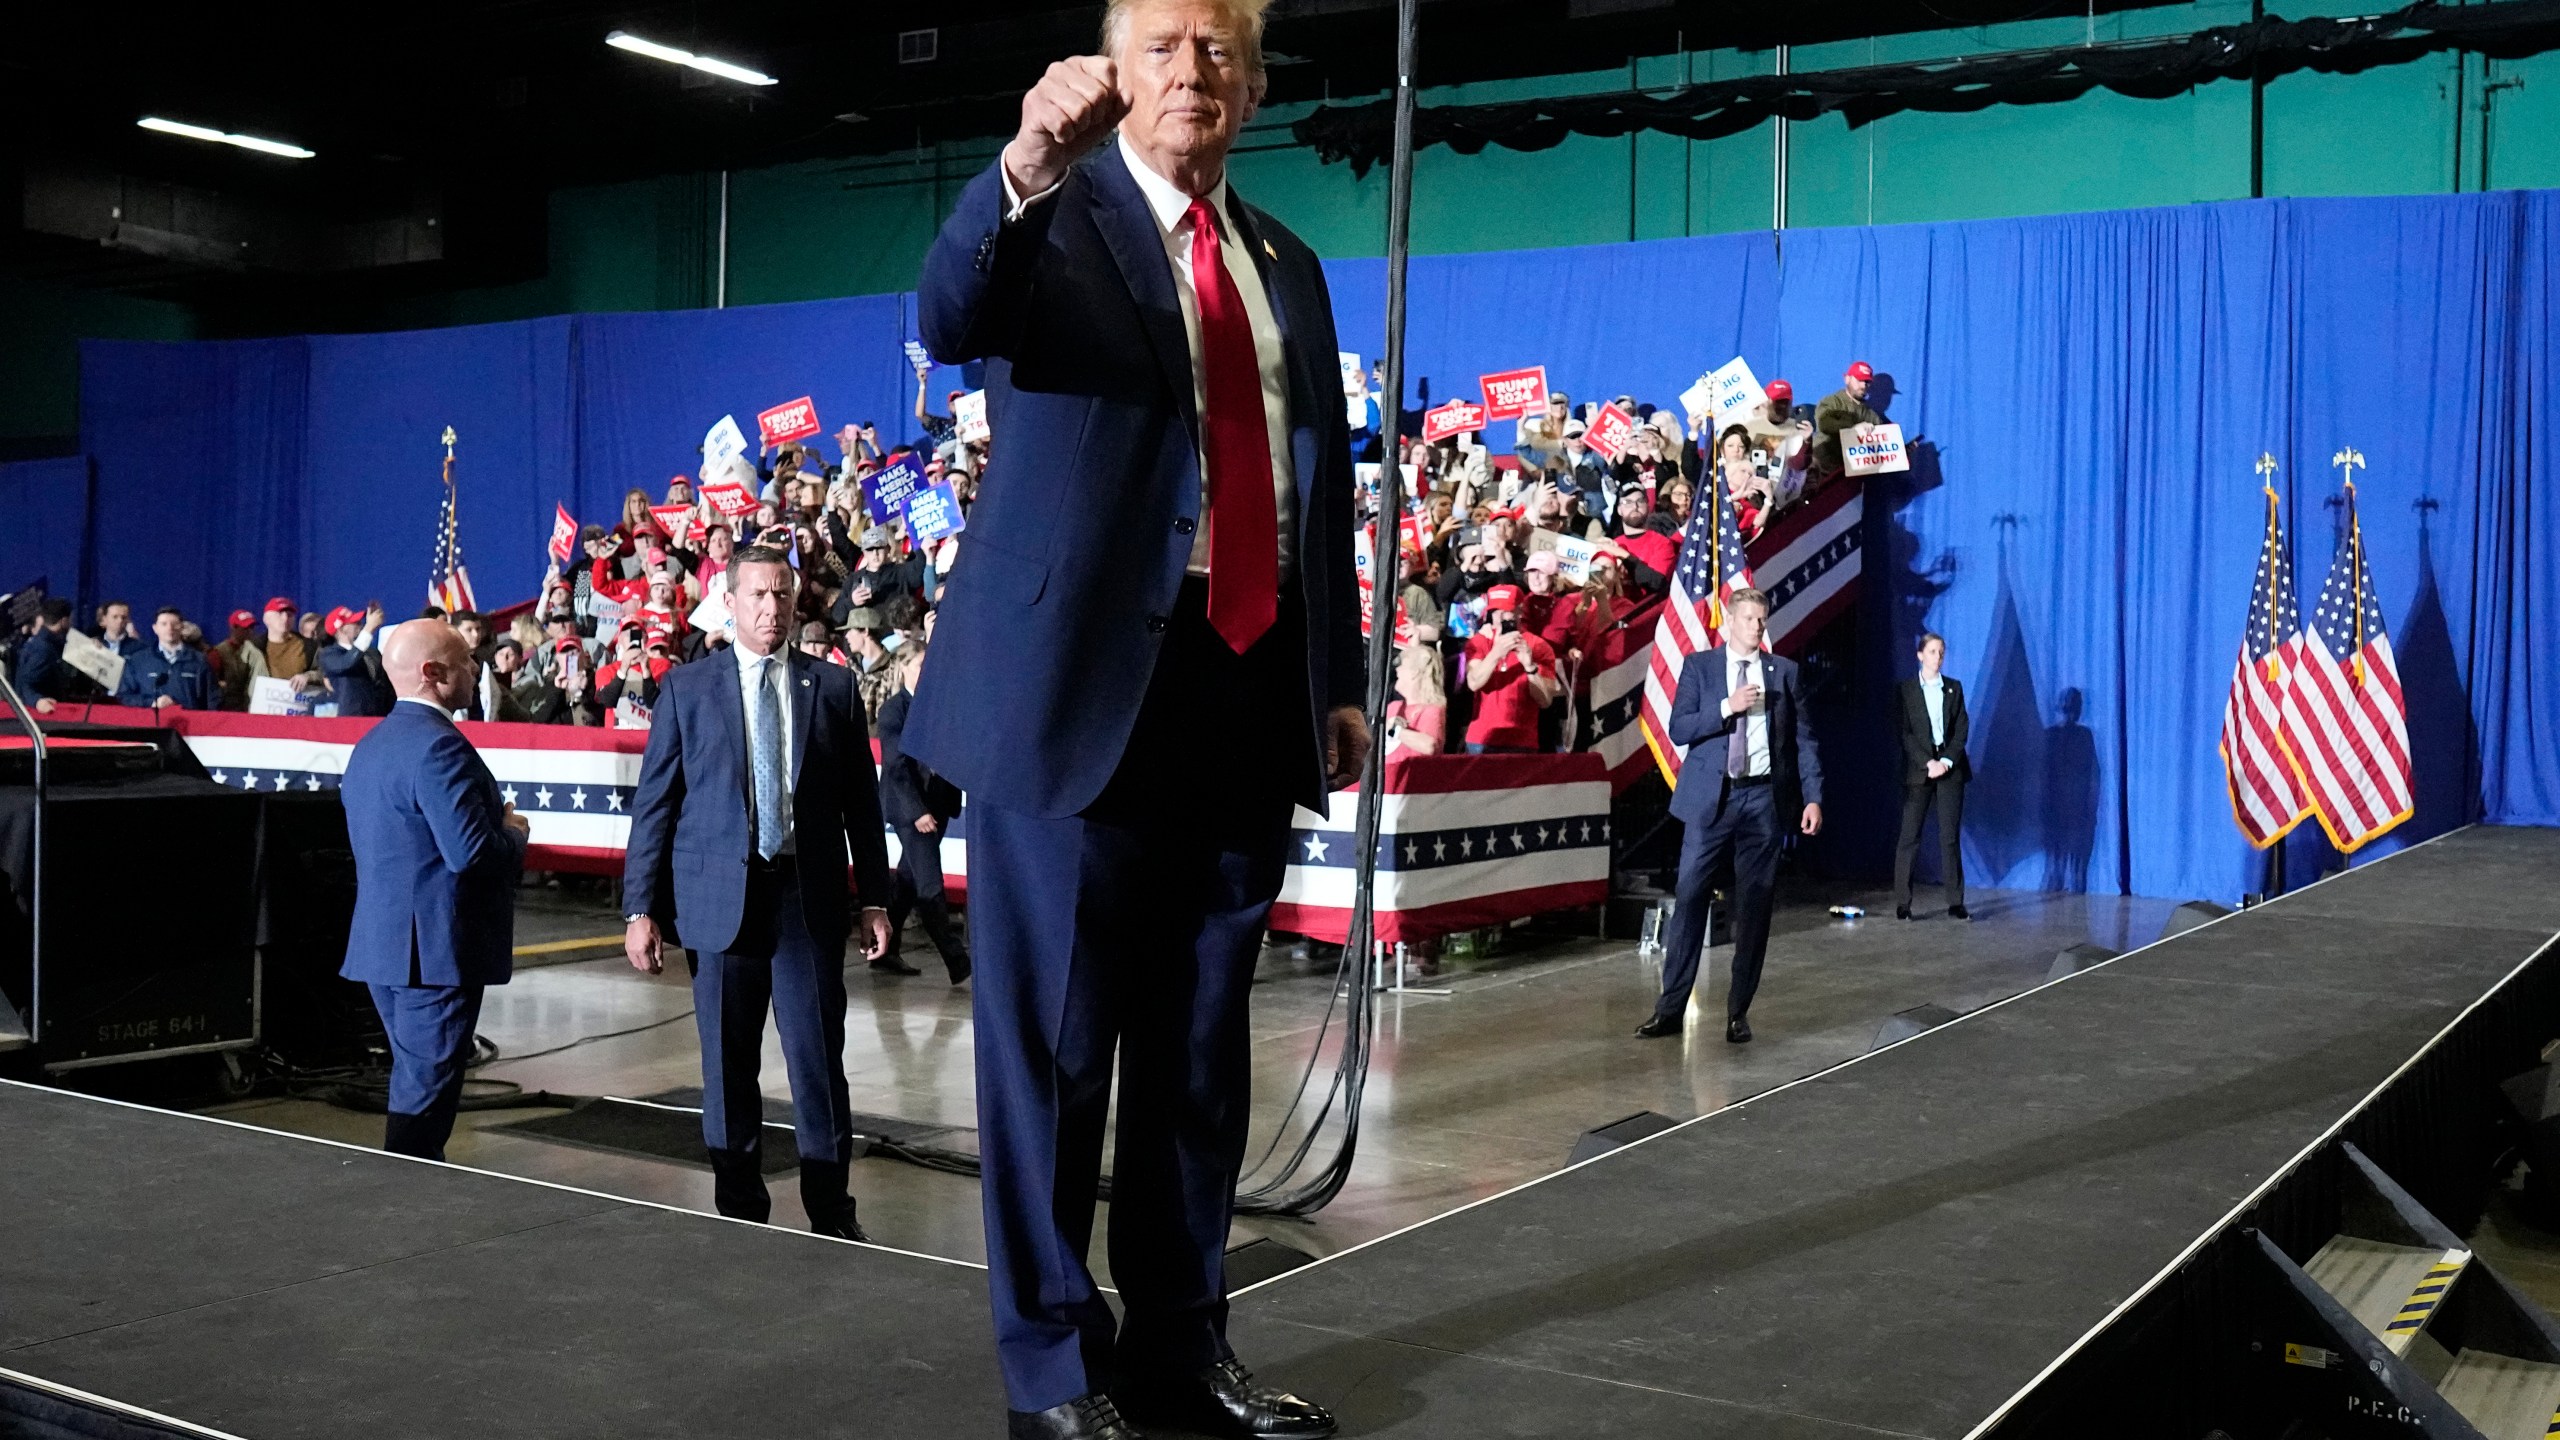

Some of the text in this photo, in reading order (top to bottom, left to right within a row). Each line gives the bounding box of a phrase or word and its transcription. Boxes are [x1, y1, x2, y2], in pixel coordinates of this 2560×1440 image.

[1486, 377, 1539, 395] TRUMP
[1496, 389, 1534, 406] 2024
[1723, 390, 1746, 408] RIG
[764, 405, 808, 427] TRUMP
[773, 416, 806, 434] 2024
[1604, 412, 1630, 438] TRU
[714, 429, 728, 444] BIG
[1601, 428, 1626, 450] 20
[1857, 433, 1888, 444] VOTE
[719, 442, 731, 457] RIG
[1848, 443, 1899, 456] DONALD
[1855, 454, 1897, 466] TRUMP
[877, 463, 907, 486] MAKE
[874, 470, 919, 500] AMERICA
[883, 481, 915, 505] GREAT
[1567, 548, 1589, 560] BIG
[630, 704, 652, 722] TRU
[98, 1019, 159, 1042] STAGE
